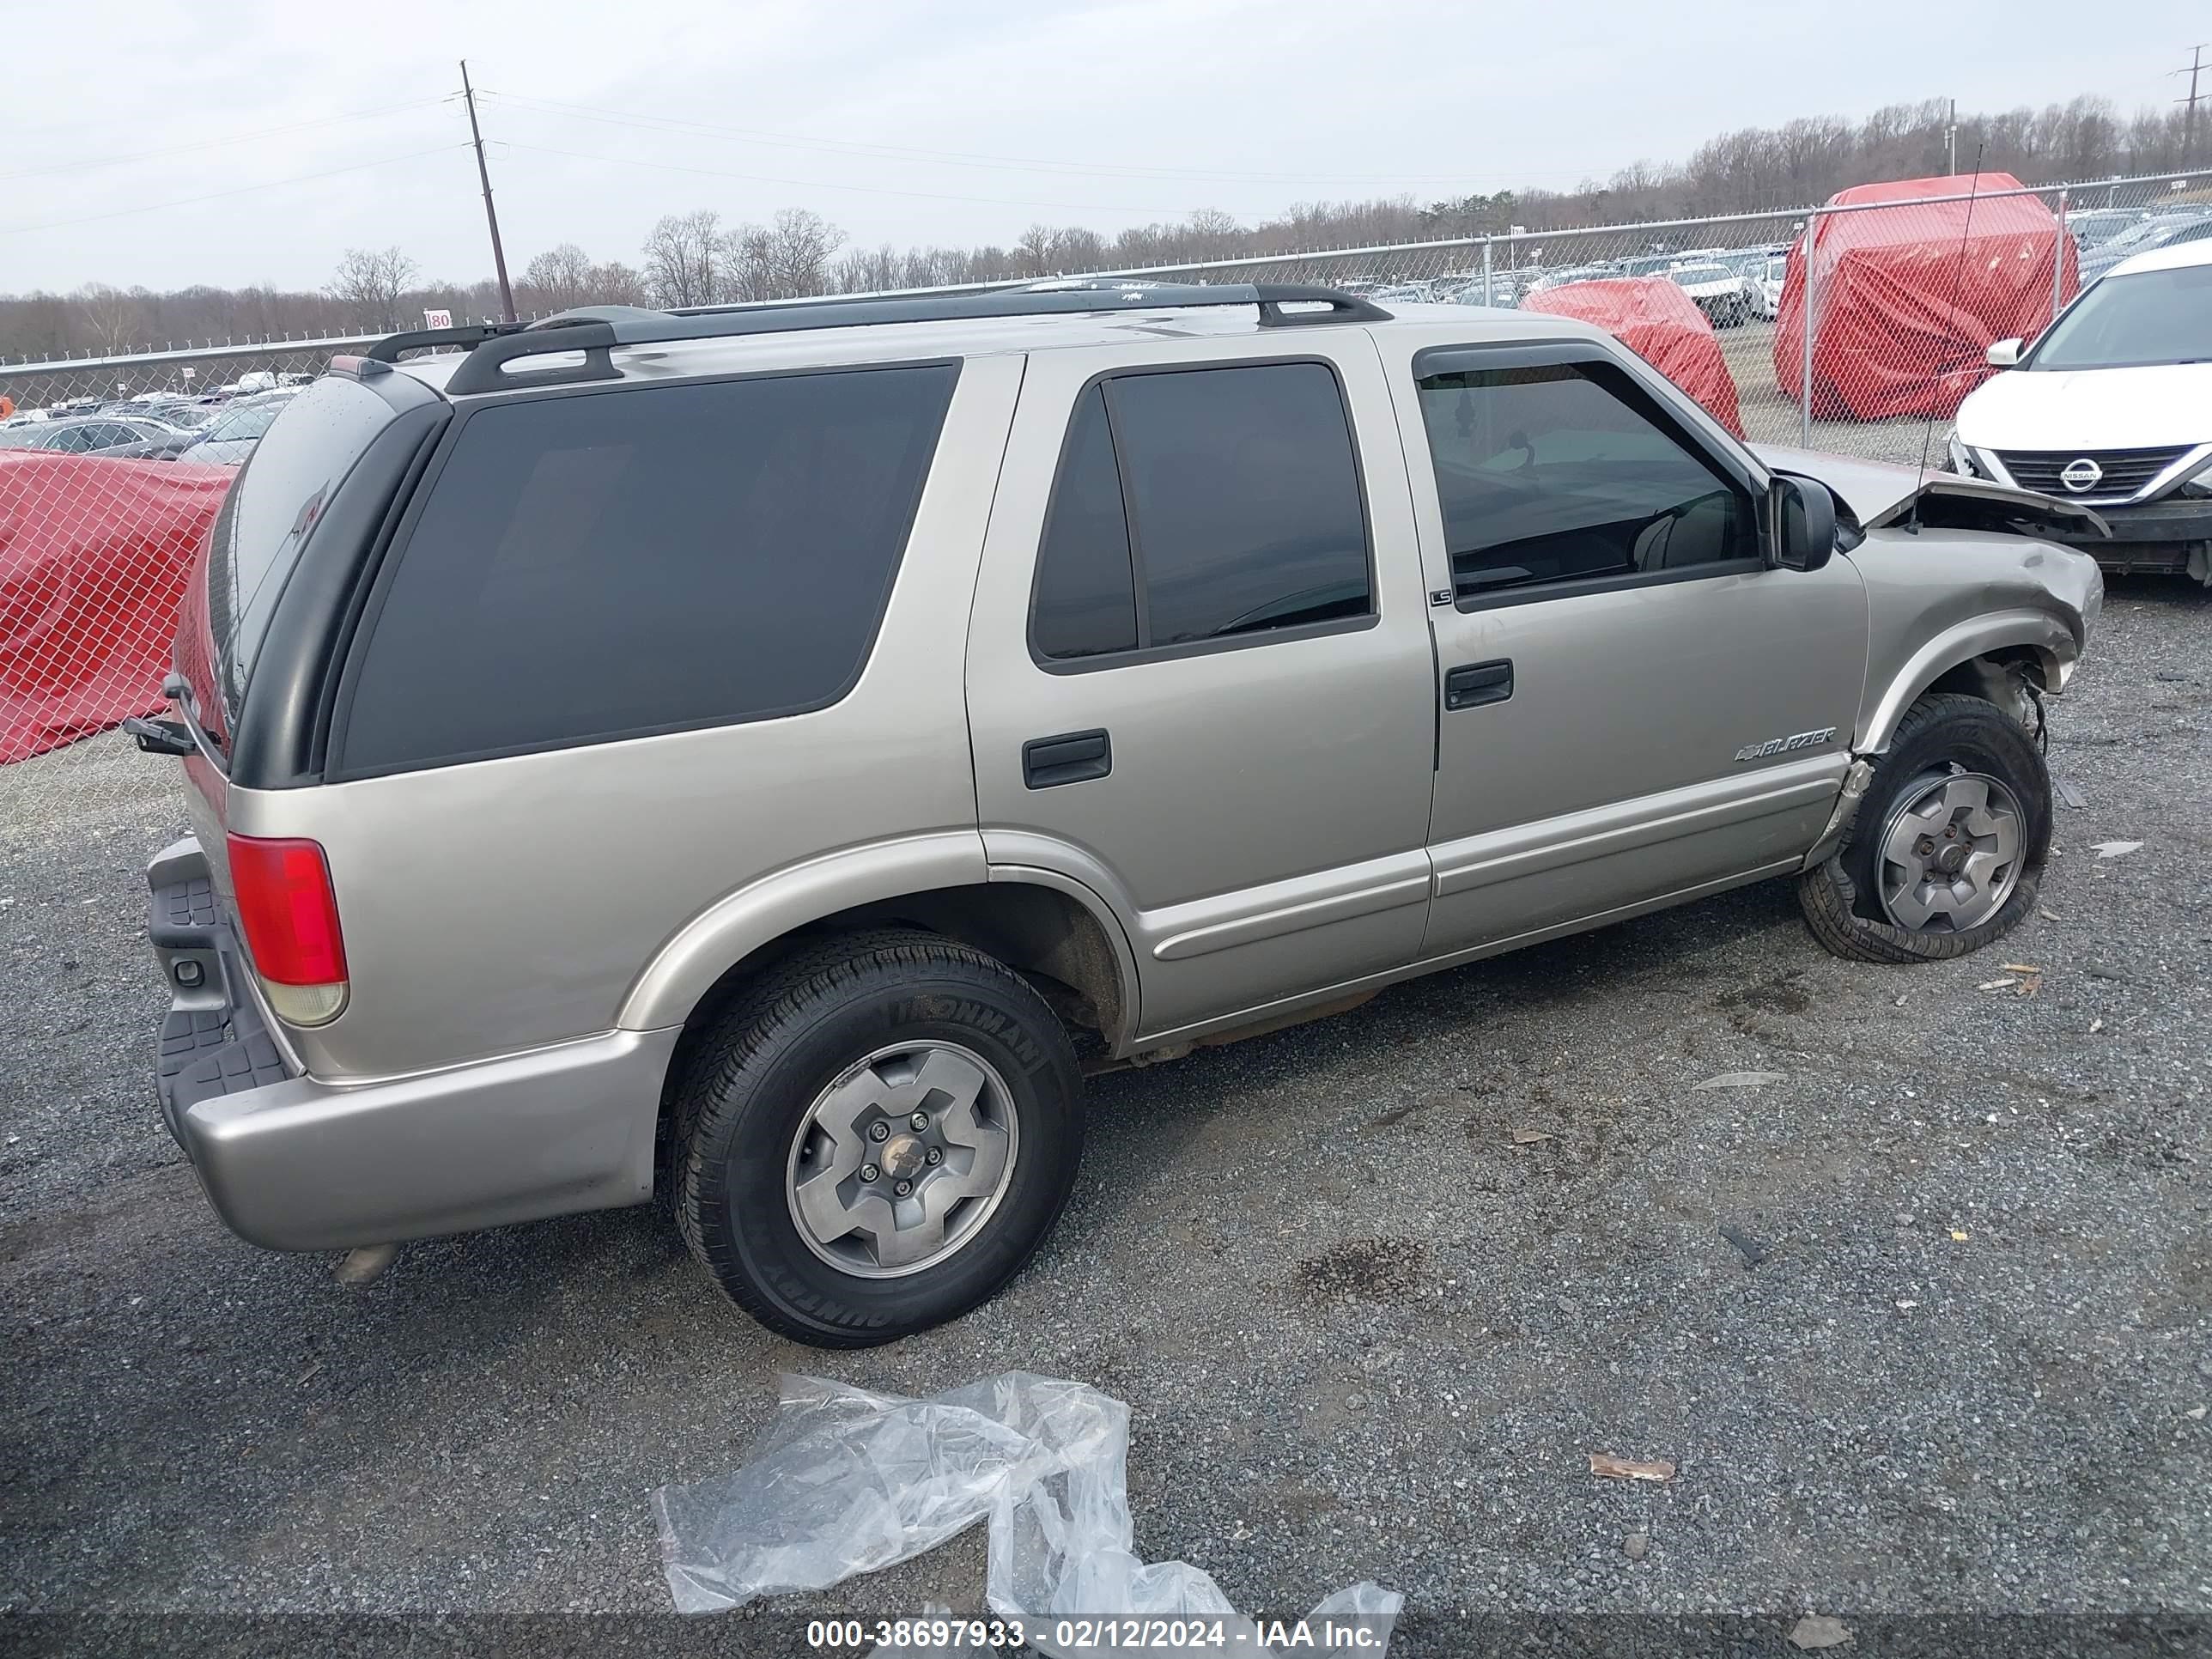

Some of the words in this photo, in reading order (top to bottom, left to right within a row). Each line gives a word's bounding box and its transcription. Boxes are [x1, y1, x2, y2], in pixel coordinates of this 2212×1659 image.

[432, 314, 450, 327] 80
[1431, 591, 1451, 605] LS
[1758, 726, 1837, 757] BLAZER
